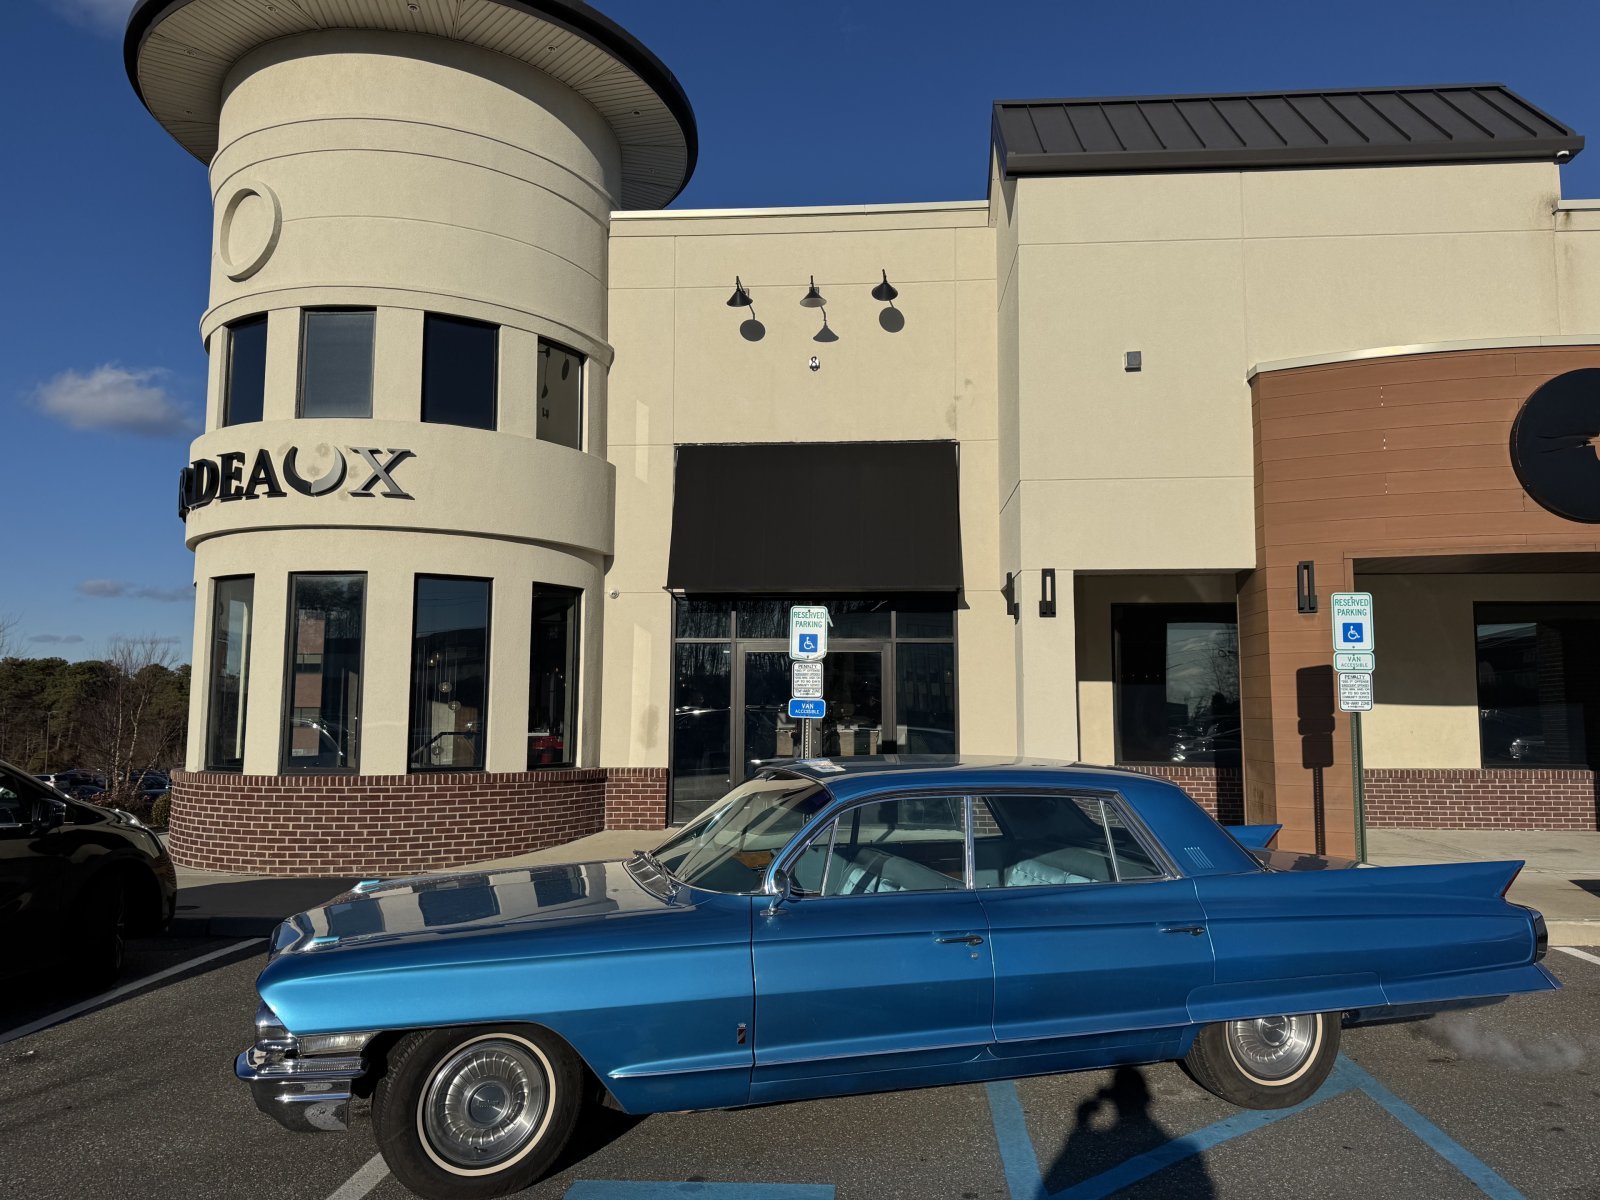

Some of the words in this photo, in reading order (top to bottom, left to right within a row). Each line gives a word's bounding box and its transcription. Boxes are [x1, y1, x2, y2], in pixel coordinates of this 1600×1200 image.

[1334, 598, 1369, 607] RESERVED
[793, 611, 825, 619] RESERVED
[1337, 608, 1367, 616] PARKING
[795, 620, 823, 628] PARKING
